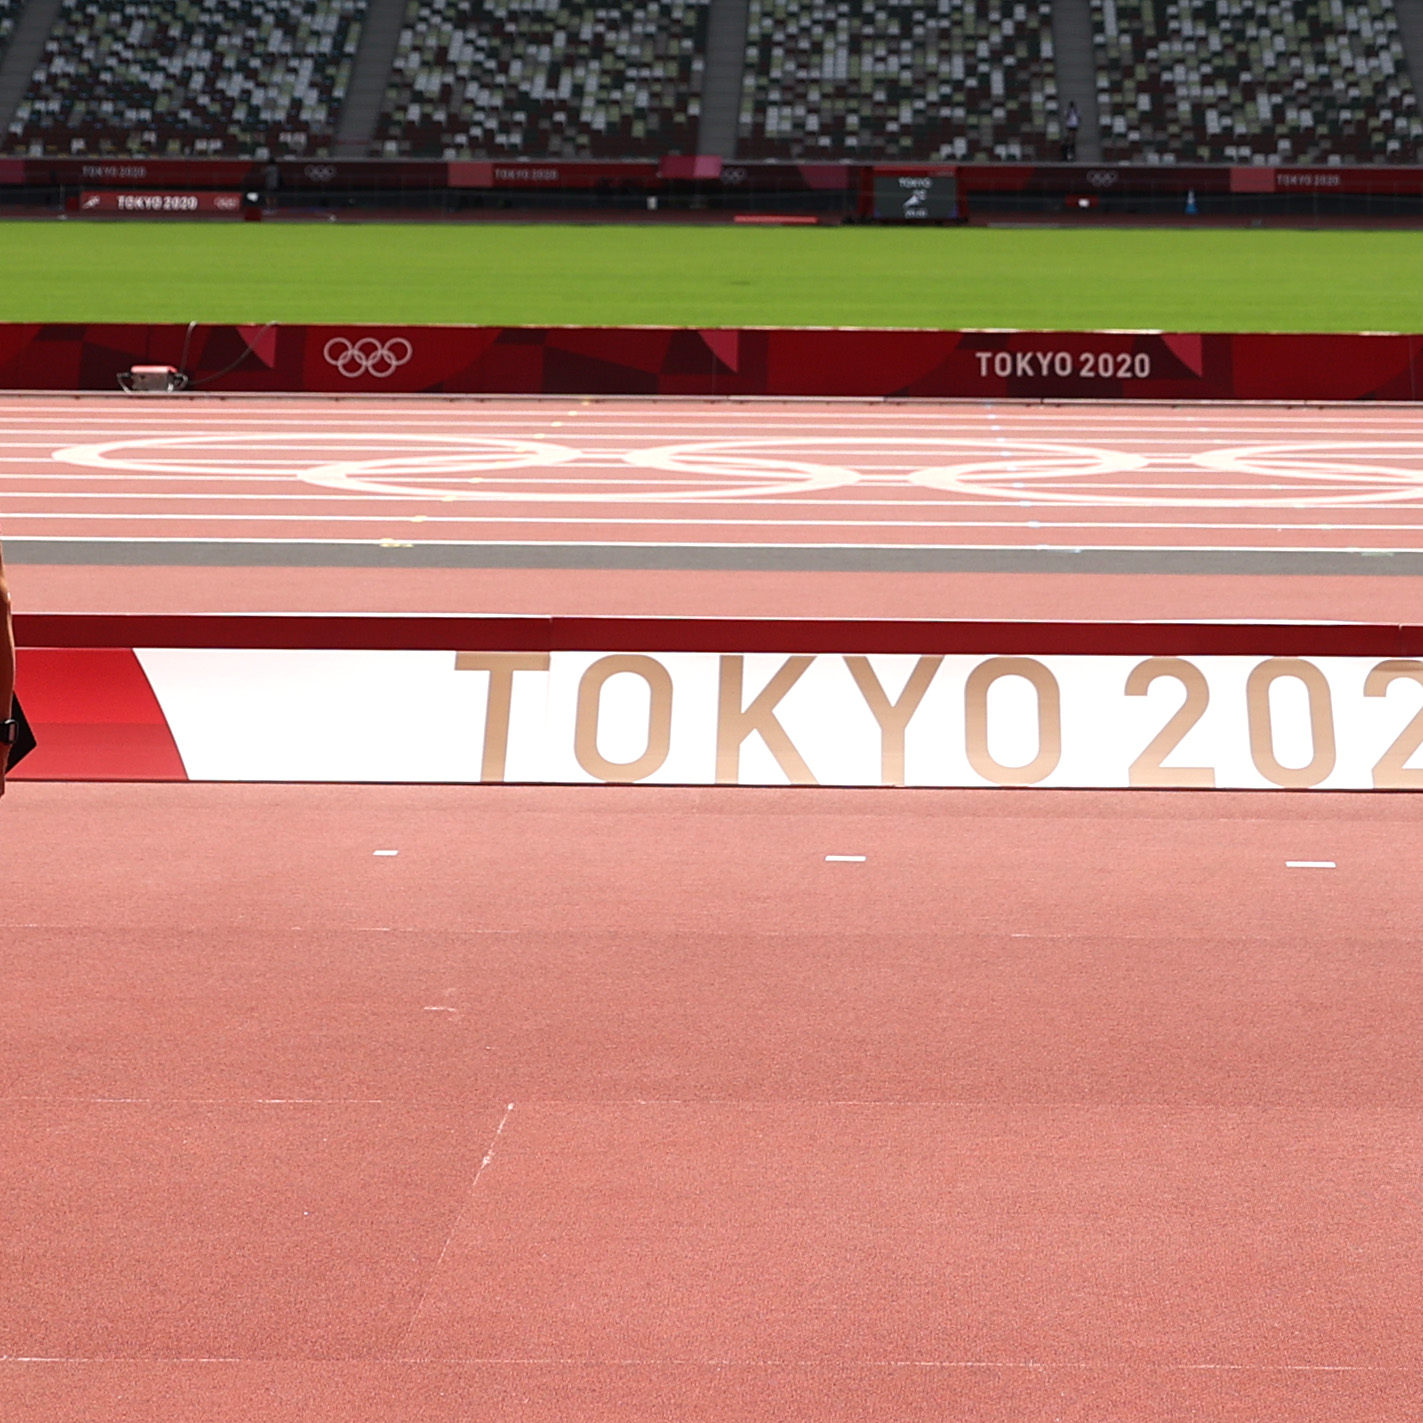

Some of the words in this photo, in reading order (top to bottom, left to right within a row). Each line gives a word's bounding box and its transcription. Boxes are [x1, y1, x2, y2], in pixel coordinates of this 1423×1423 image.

[117, 194, 163, 211] TOKYO
[163, 195, 198, 211] 2020
[975, 351, 1073, 377] TOKYO
[1078, 353, 1152, 378] 2020
[454, 650, 1061, 787] TOKYO
